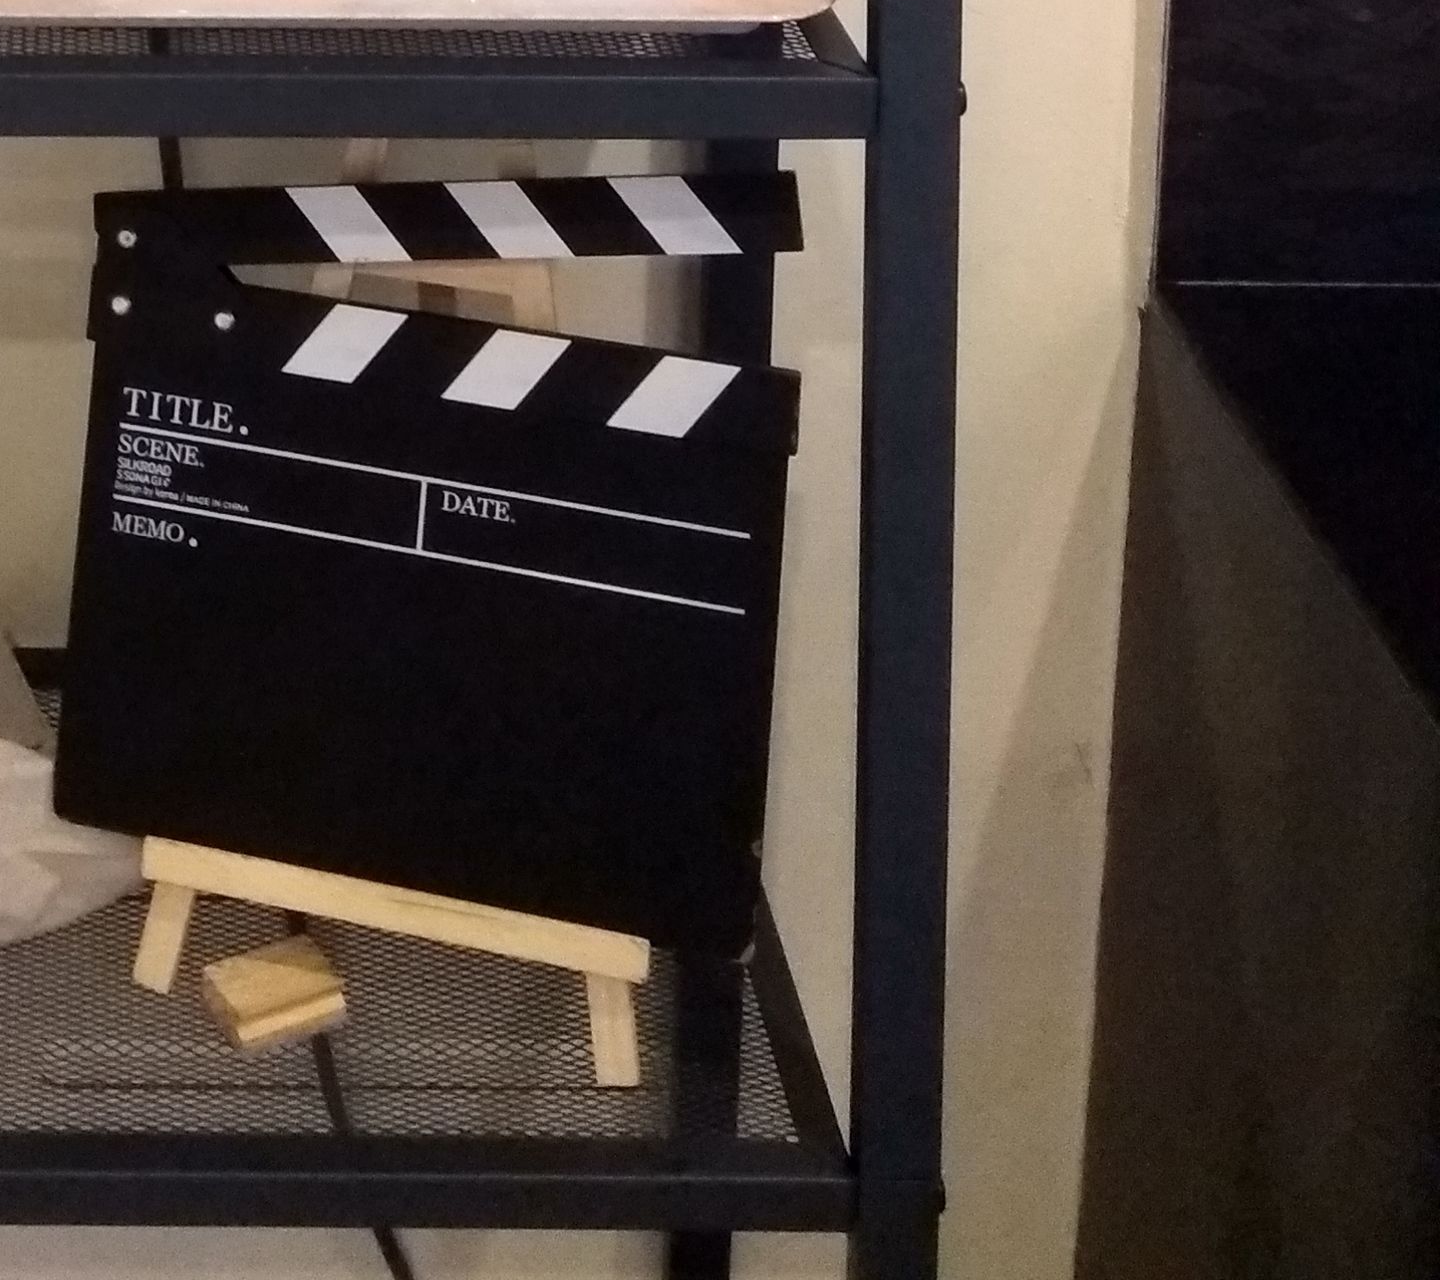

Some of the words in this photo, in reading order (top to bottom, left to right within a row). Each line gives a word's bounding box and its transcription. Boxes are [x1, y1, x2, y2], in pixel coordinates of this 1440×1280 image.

[122, 386, 250, 436] TITLE.
[117, 433, 205, 468] SCENE.
[441, 490, 516, 524] DATE.
[111, 511, 199, 548] MEMO.
